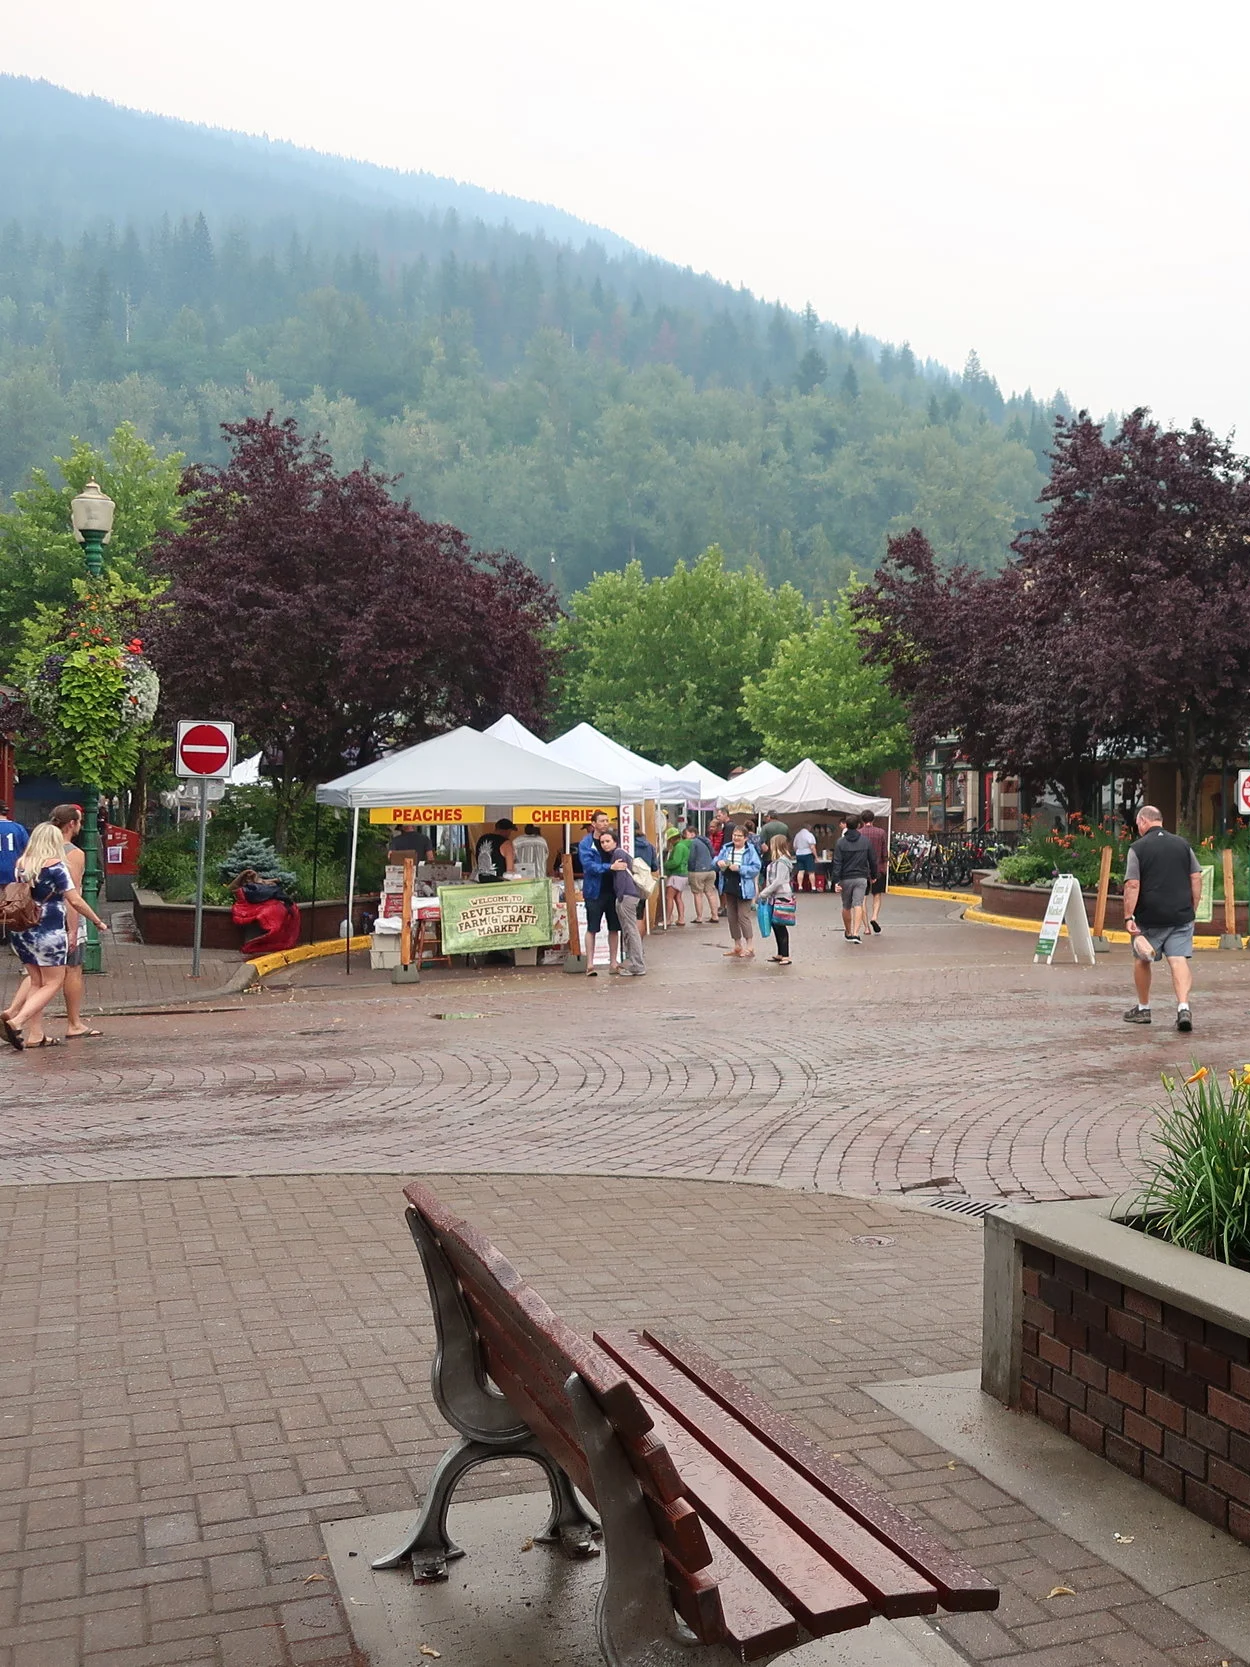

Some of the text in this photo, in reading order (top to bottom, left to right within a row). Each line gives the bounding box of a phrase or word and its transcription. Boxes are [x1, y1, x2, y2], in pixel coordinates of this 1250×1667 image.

[392, 808, 463, 822] PEACHES
[470, 895, 523, 906] WELCOME TO
[461, 905, 533, 920] REVELSTOKE
[458, 918, 488, 931] FARM
[502, 915, 537, 924] CRAFT
[477, 924, 520, 936] MARKET
